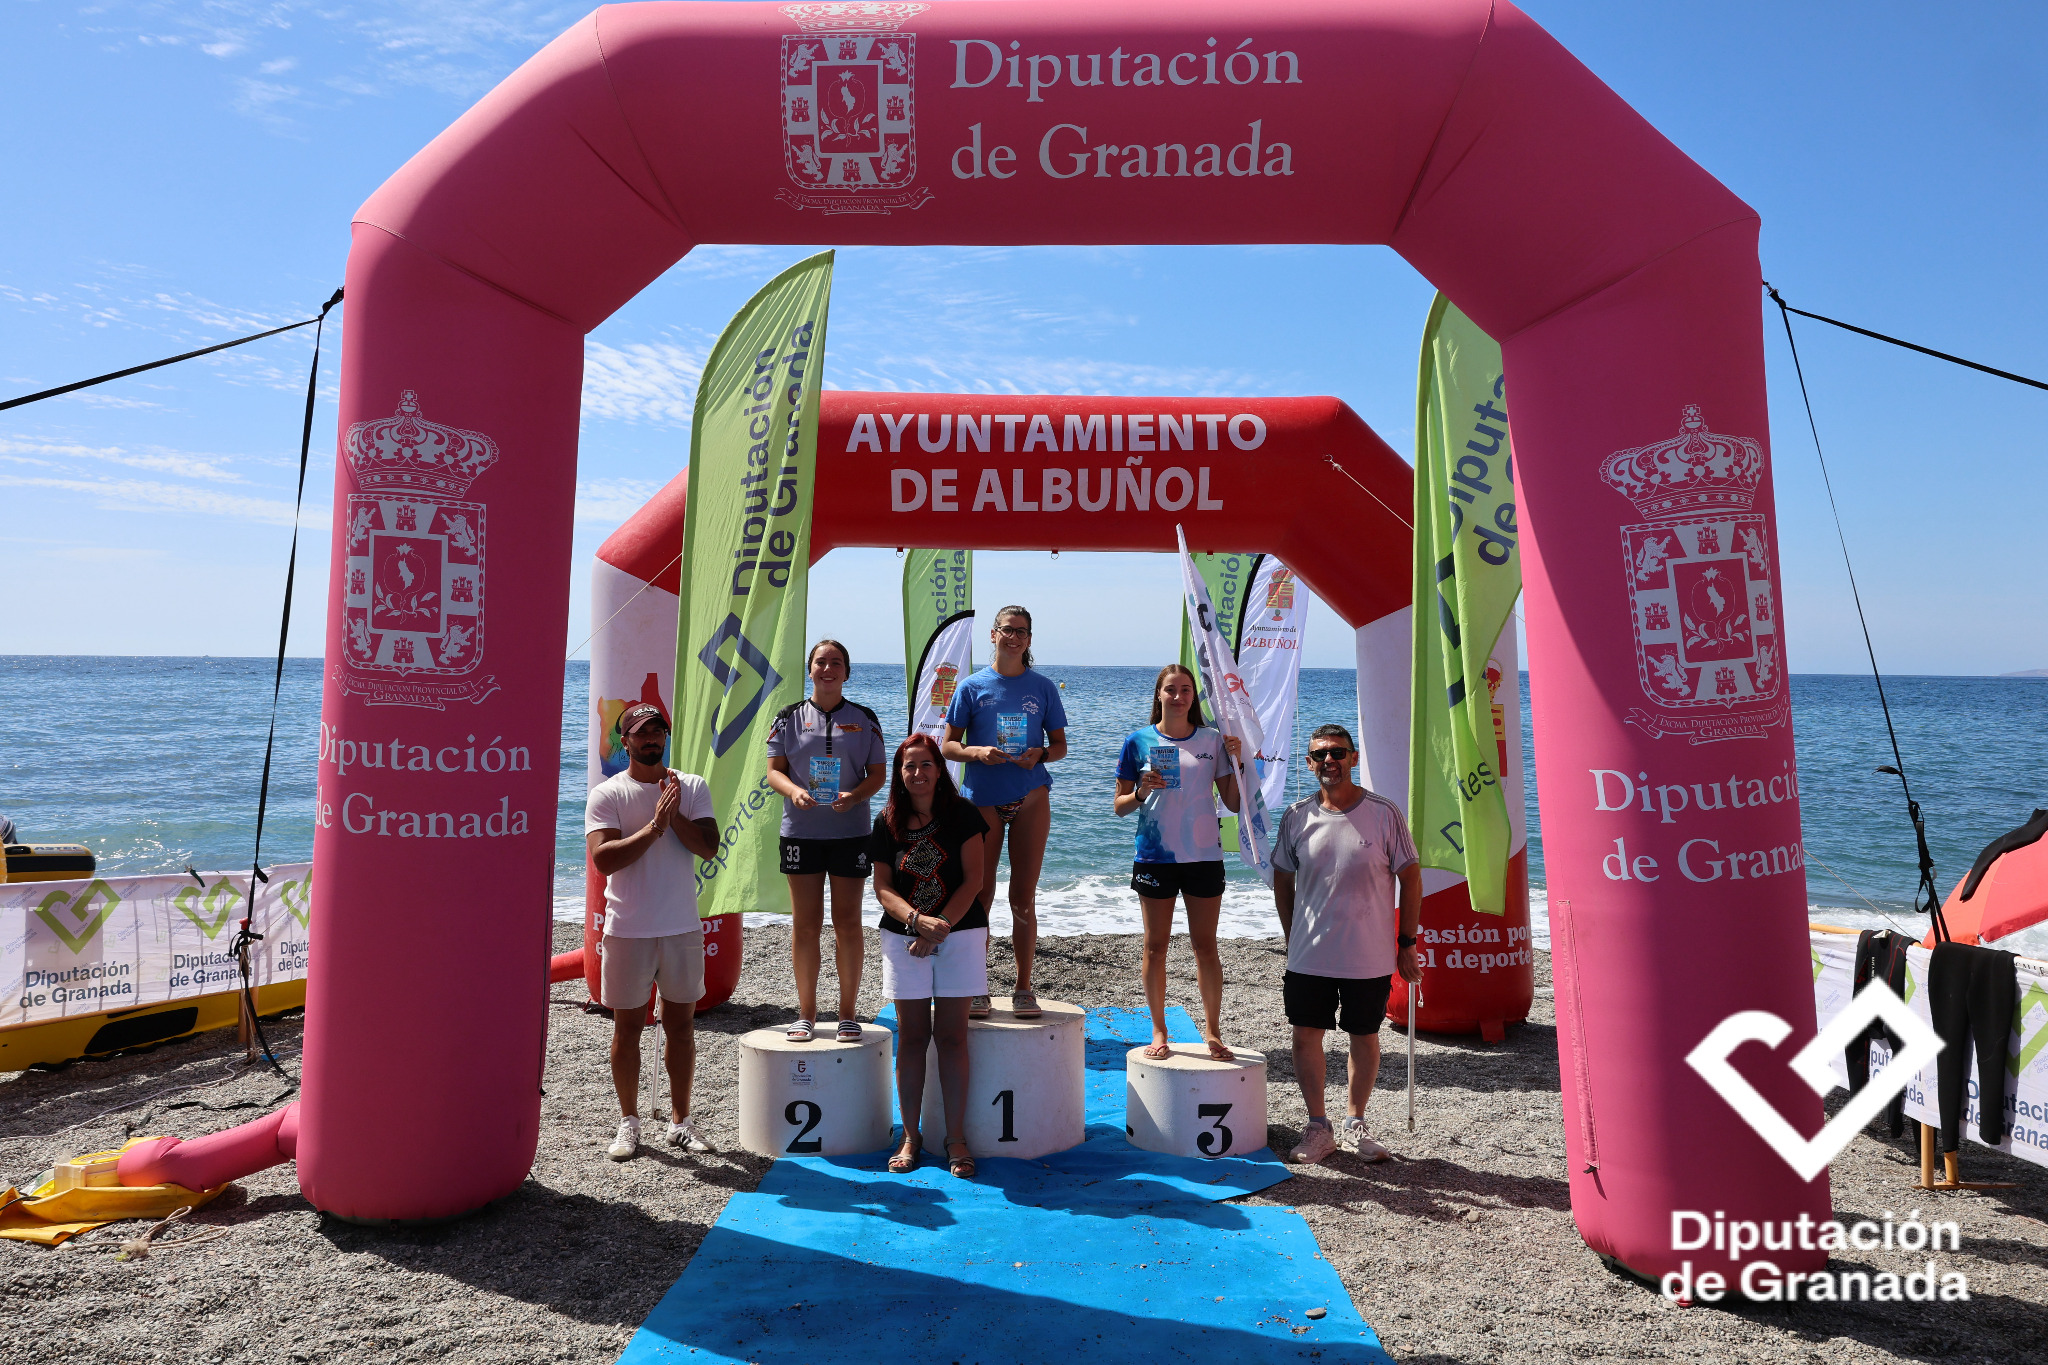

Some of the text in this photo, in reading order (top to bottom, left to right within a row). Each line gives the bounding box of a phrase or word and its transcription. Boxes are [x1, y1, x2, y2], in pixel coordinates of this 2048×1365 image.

[949, 37, 1302, 102] Diputación
[951, 119, 1295, 180] de Granada
[845, 413, 1267, 453] AYUNTAMIENTO
[732, 347, 776, 596] Diputación
[890, 455, 1224, 512] DE ALBUÑOL
[758, 530, 796, 588] de
[1244, 636, 1299, 650] ALBUÑOL
[373, 690, 433, 703] GRANADA
[412, 684, 458, 695] PROVINCIAL
[318, 721, 532, 776] Diputación
[1700, 724, 1759, 737] GRANADA
[315, 785, 530, 839] de Granada
[786, 845, 801, 863] 33
[1602, 837, 1660, 883] de
[1417, 922, 1500, 944] Pasión
[25, 960, 130, 989] Diputación
[169, 972, 190, 988] de
[278, 957, 292, 972] de
[1417, 946, 1532, 974] el deporte
[19, 991, 47, 1009] de
[51, 979, 132, 1004] Granada
[784, 1100, 823, 1154] 2
[991, 1089, 1018, 1143] 1
[1196, 1103, 1233, 1158] 3
